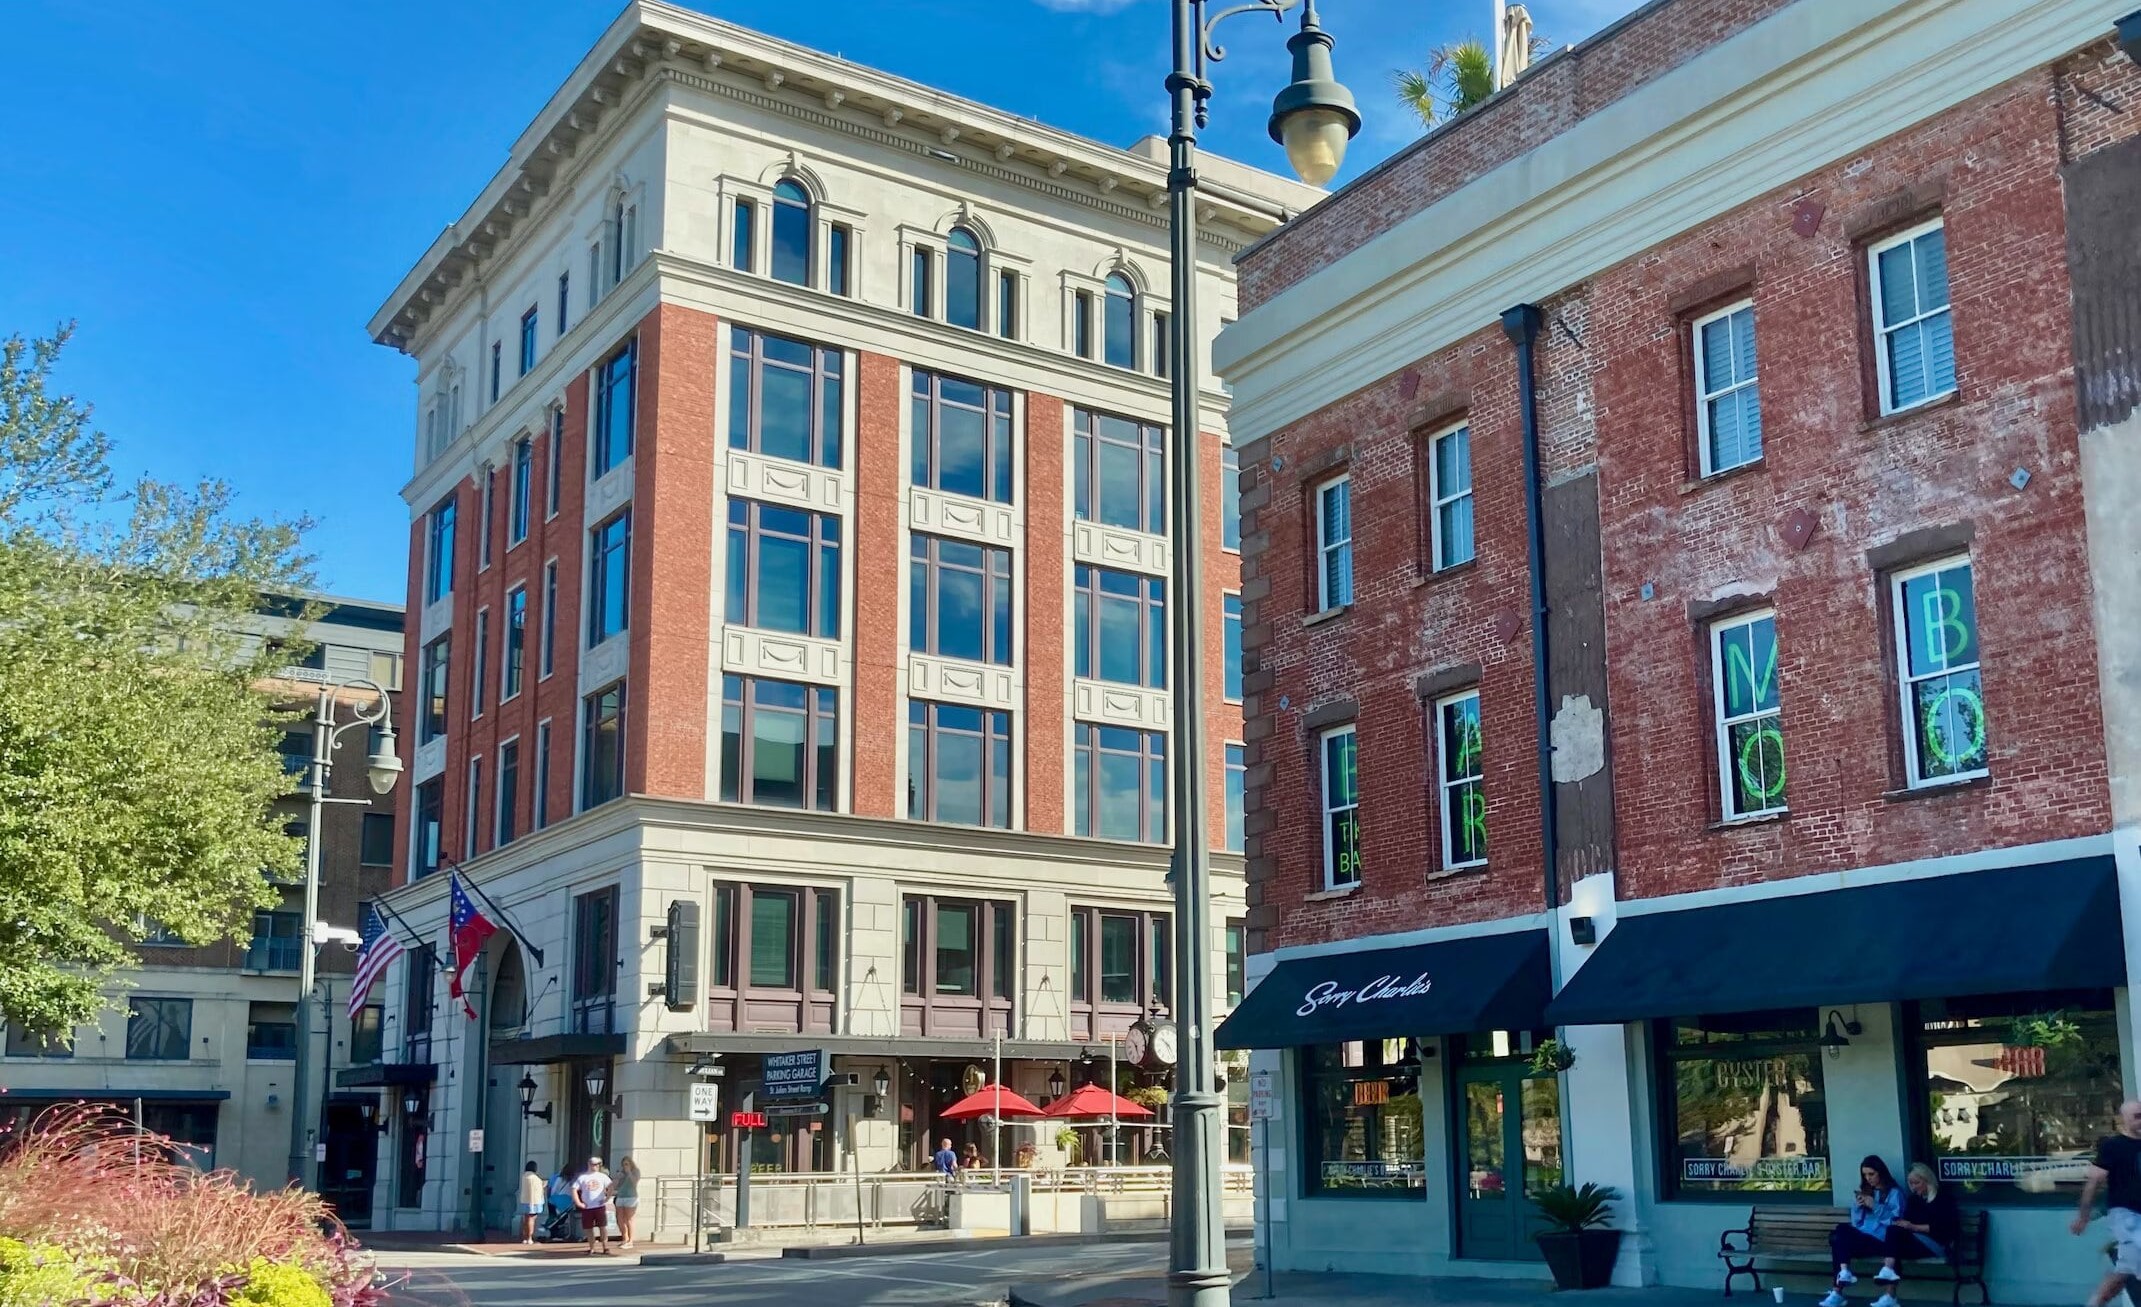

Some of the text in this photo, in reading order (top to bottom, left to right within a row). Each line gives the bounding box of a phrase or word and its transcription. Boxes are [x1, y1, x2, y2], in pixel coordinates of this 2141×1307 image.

[1922, 588, 1969, 664] B
[1927, 687, 1985, 764] O
[1742, 729, 1786, 799] O
[1462, 794, 1488, 854] R
[1296, 972, 1431, 1016] Sorry Charlie's
[767, 1053, 817, 1067] WHITAKER STREET
[766, 1067, 816, 1081] PARKING GARAGE
[1717, 1060, 1788, 1088] OYSTER
[695, 1087, 713, 1096] ONE
[788, 1085, 800, 1093] Street
[694, 1097, 713, 1106] WAY
[734, 1113, 765, 1126] FULL
[1688, 1163, 1715, 1176] SORRY
[1765, 1162, 1799, 1176] OYSTER
[1801, 1162, 1821, 1176] BAR
[1943, 1162, 1978, 1176] SORRY
